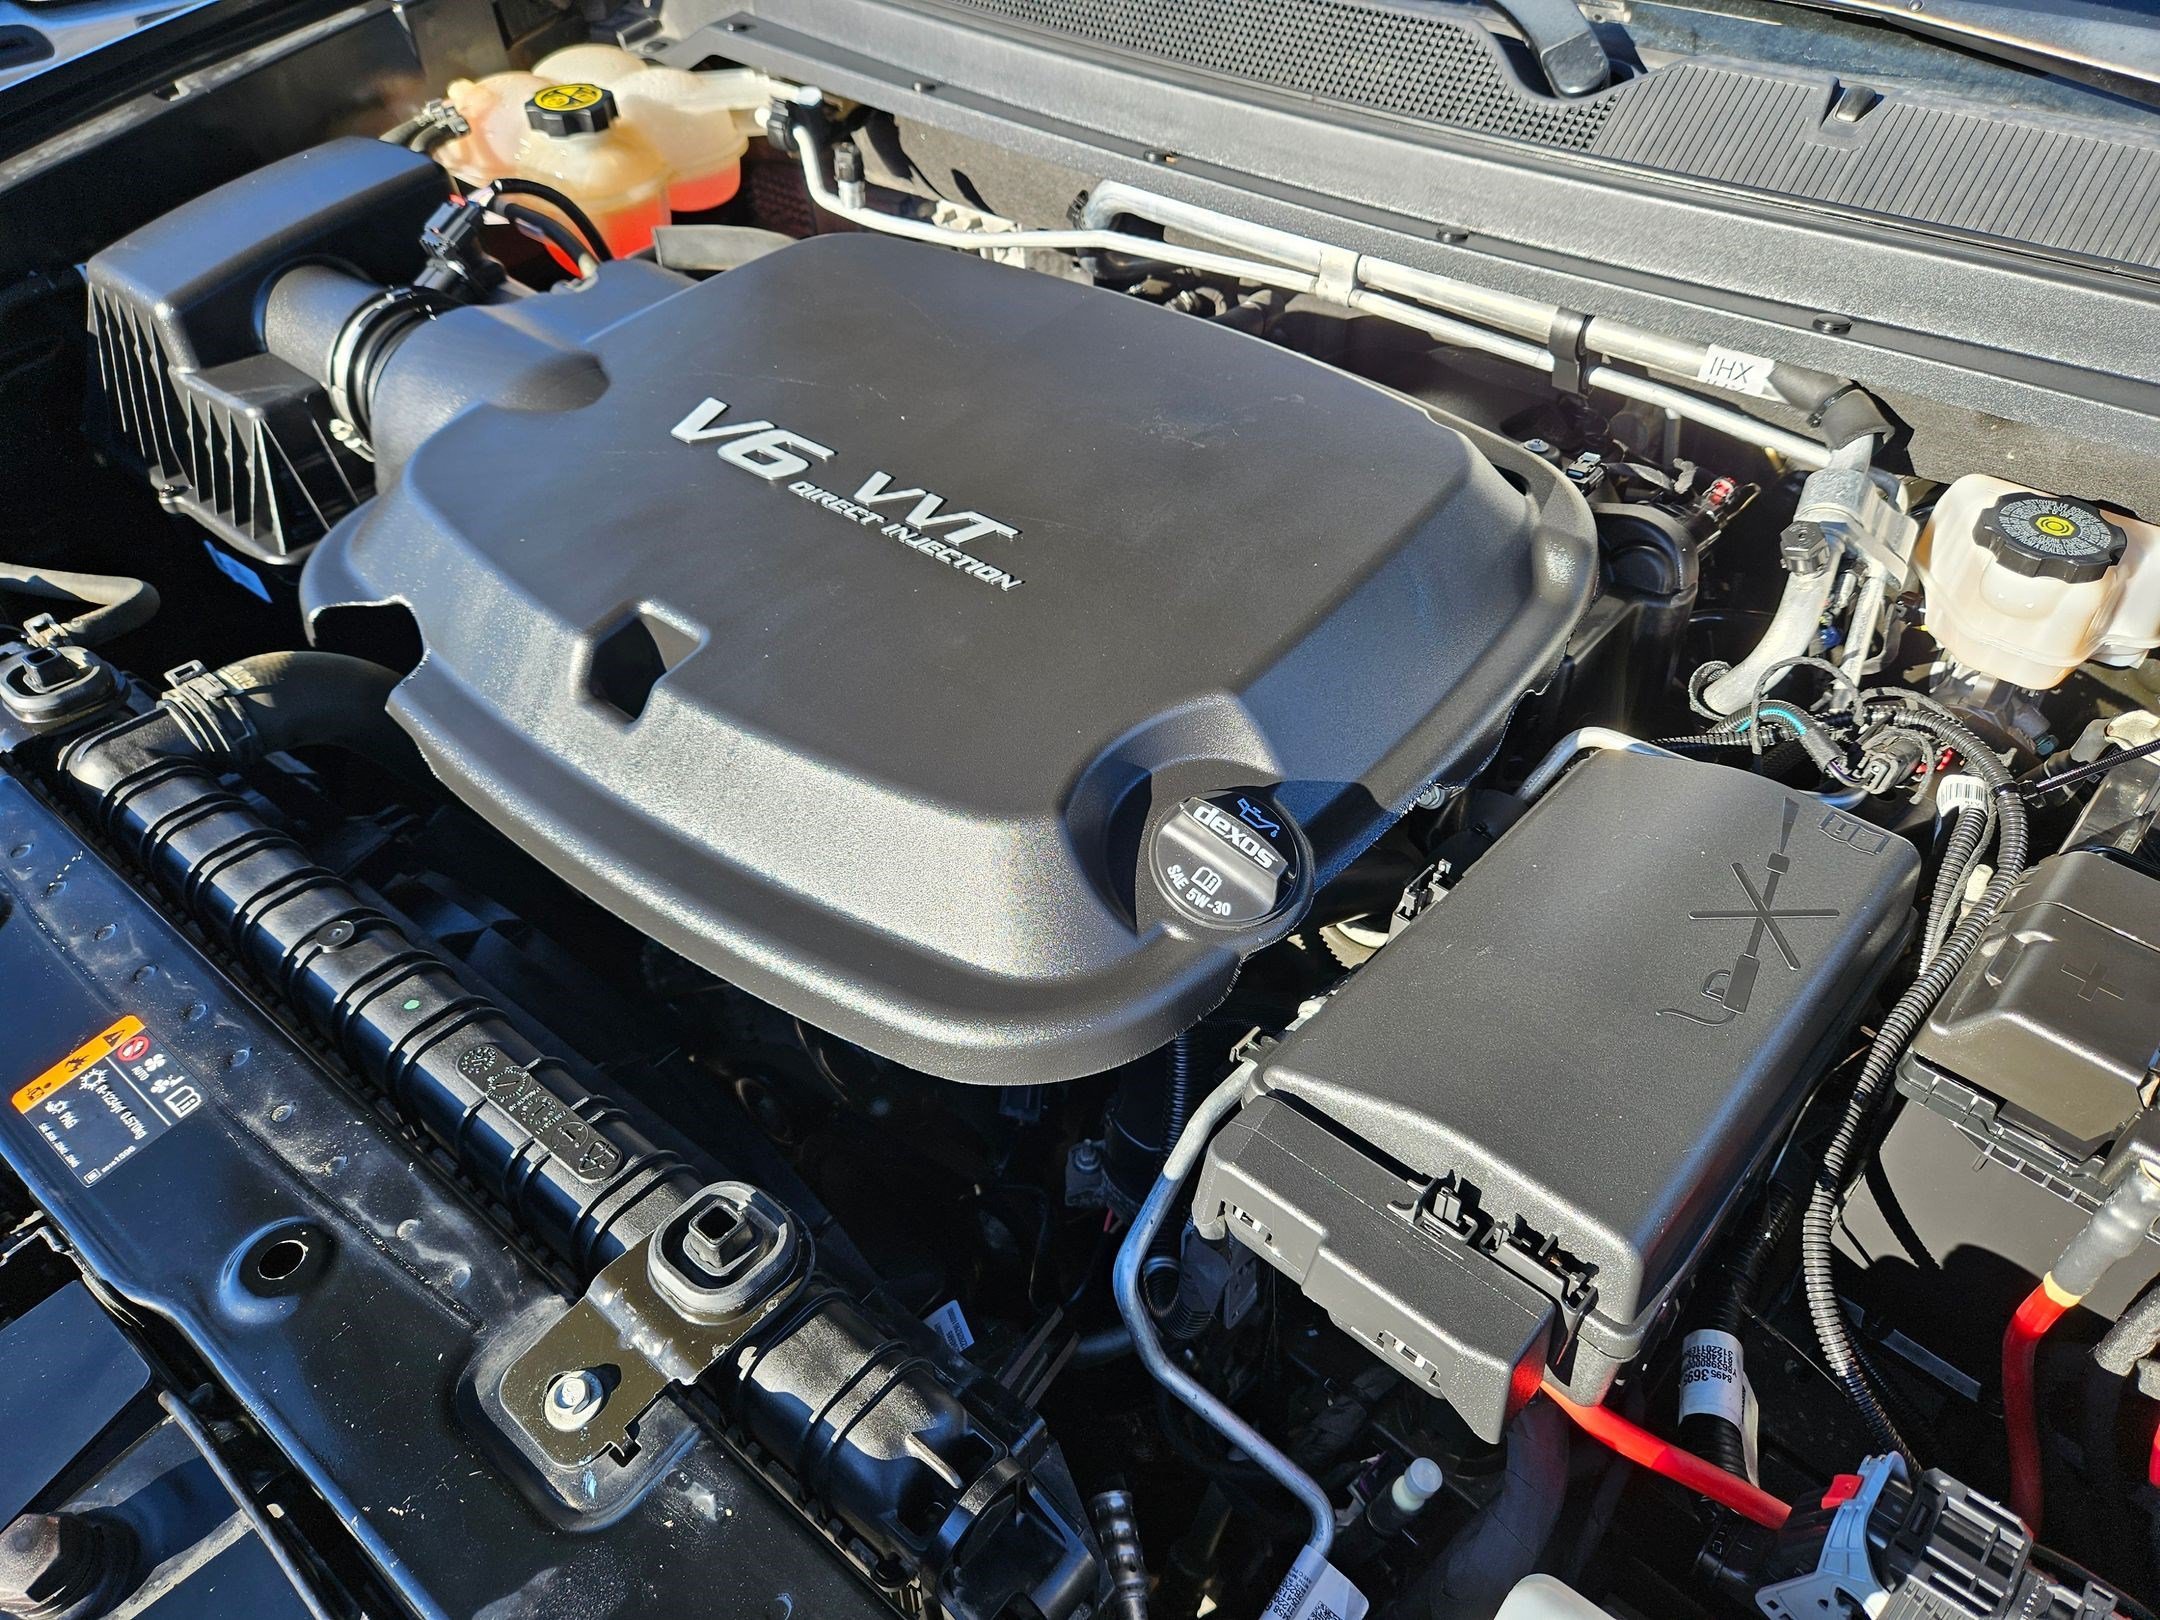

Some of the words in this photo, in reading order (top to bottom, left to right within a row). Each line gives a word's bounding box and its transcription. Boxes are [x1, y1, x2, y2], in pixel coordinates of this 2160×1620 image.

[1708, 356, 1755, 384] IHX
[670, 397, 837, 481] V6
[853, 470, 1021, 546] VVT
[788, 480, 888, 526] DIRECT
[881, 522, 1025, 591] INJECTION
[1193, 805, 1276, 869] dexos
[1166, 864, 1189, 890] SAE
[1185, 887, 1232, 916] 5W-30
[58, 1110, 79, 1130] PAG
[119, 1110, 149, 1140] 0.570kg
[1710, 1369, 1732, 1384] 8495
